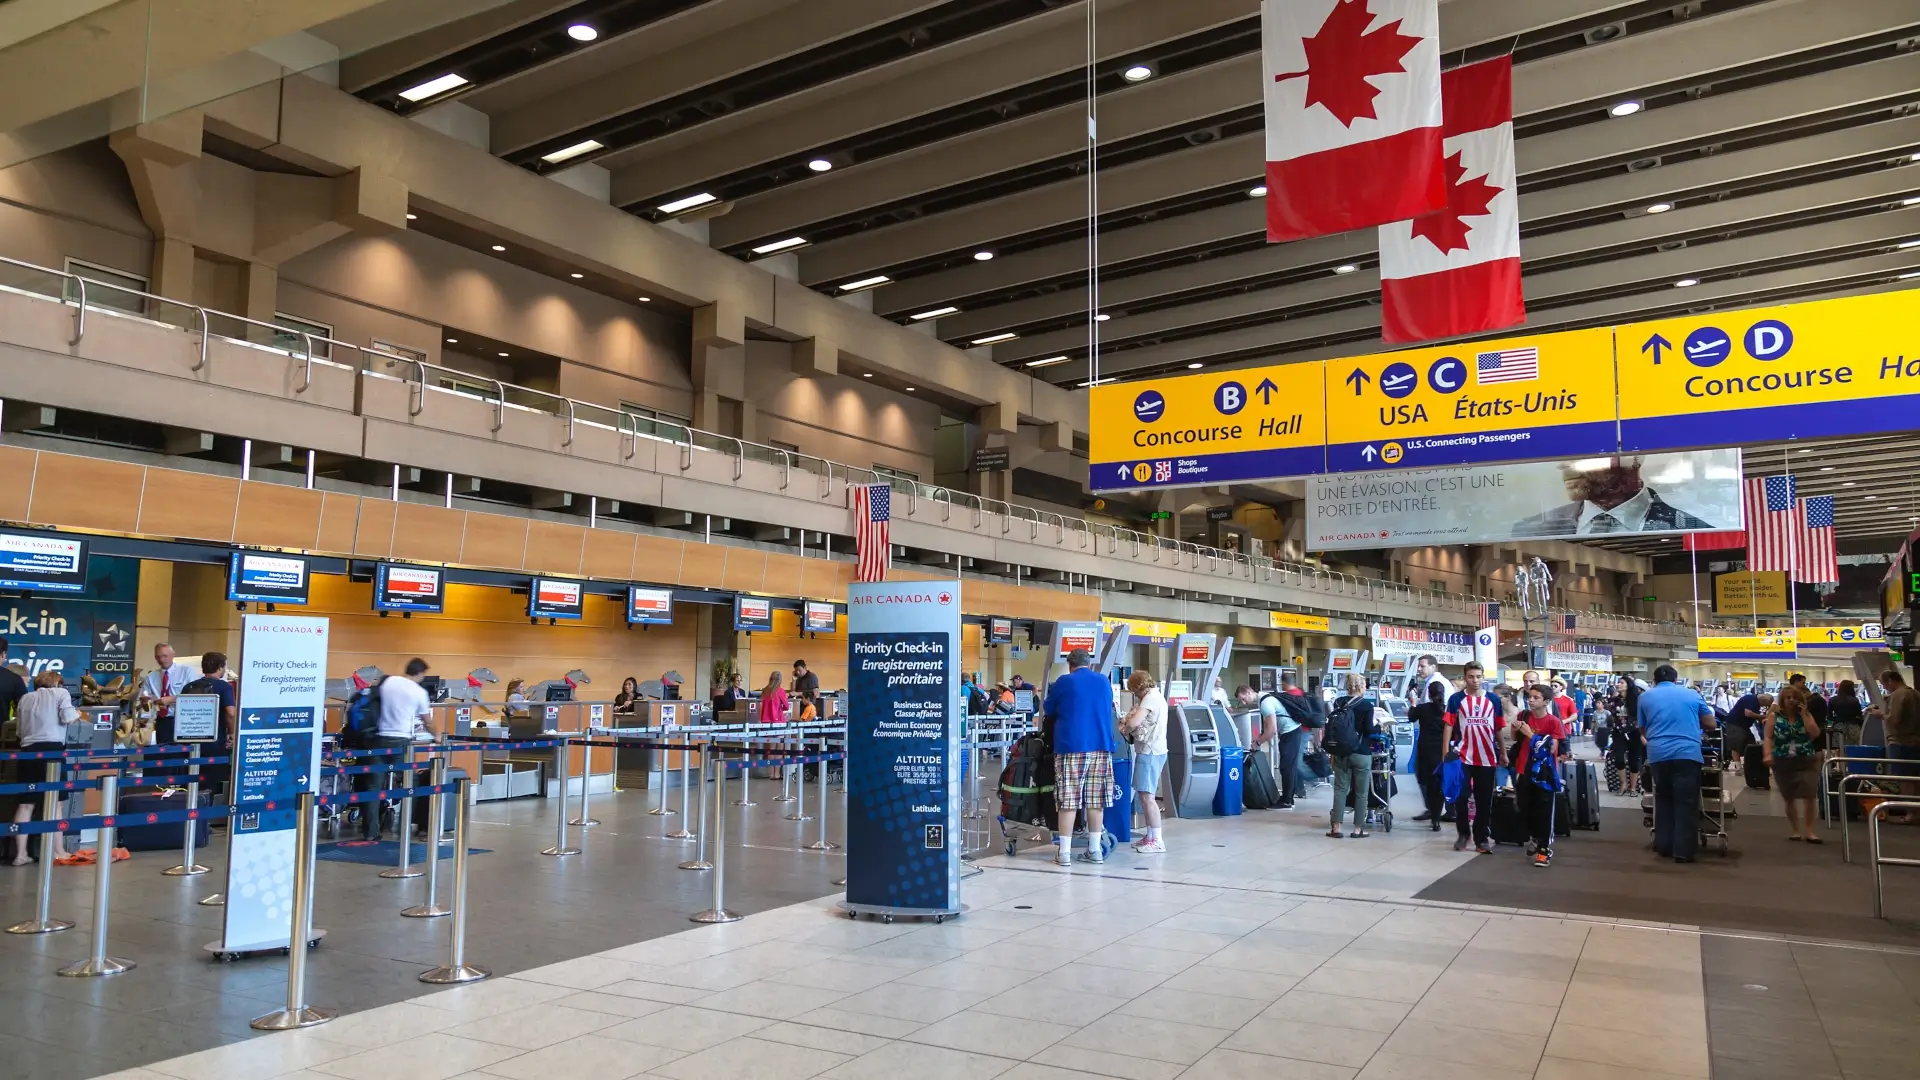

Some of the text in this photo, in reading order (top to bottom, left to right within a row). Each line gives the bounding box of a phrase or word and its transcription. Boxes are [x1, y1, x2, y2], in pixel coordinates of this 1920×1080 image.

[1755, 327, 1784, 356] D
[1435, 363, 1456, 388] C
[1685, 366, 1852, 397] Concourse
[1223, 387, 1240, 410] B
[1380, 389, 1577, 426] USA États-Unis
[1133, 414, 1302, 447] Concourse Hall
[1407, 432, 1530, 450] U.S. Connecting Passengers
[1178, 459, 1198, 467] Shops
[1178, 465, 1208, 475] Boutiques
[1317, 487, 1347, 500] UNE
[1352, 482, 1420, 497] ÉVASION.
[1426, 476, 1466, 492] C'EST
[1471, 474, 1504, 489] UNE
[1318, 495, 1440, 518] PORTE D'ENTRÉE.
[1318, 532, 1376, 542] AIR CANADA
[24, 541, 63, 550] CANADA
[853, 594, 932, 605] AIR CANADA
[1387, 627, 1463, 644] UNITED STATES
[855, 642, 942, 656] Priority Check-in
[1579, 644, 1595, 654] UNIS
[96, 663, 129, 672] GOLD
[252, 661, 317, 670] Priority Check-in
[862, 659, 943, 673] Enregistrement
[261, 675, 316, 684] Enregistrement
[888, 673, 942, 687] prioritaire
[280, 685, 315, 694] prioritaire
[917, 710, 942, 719] affaires
[910, 722, 942, 731] Economy
[873, 729, 942, 739] Économique Privilège
[896, 756, 942, 764] ALTITUDE
[912, 804, 941, 813] Latitude
